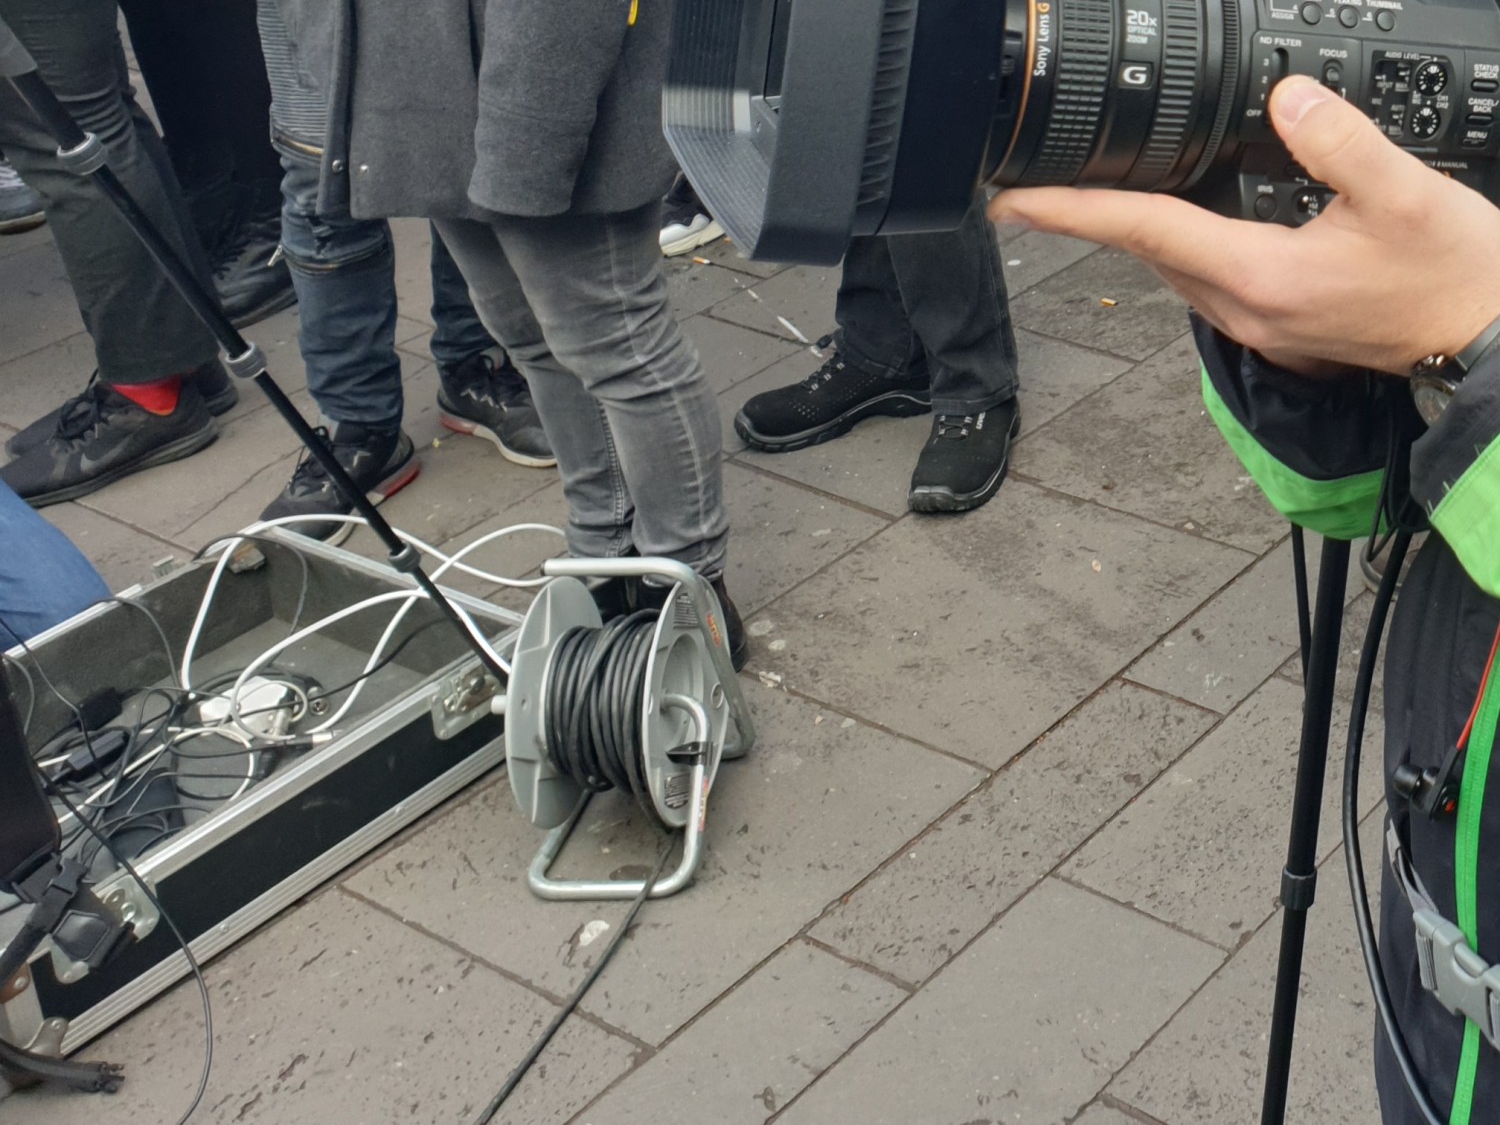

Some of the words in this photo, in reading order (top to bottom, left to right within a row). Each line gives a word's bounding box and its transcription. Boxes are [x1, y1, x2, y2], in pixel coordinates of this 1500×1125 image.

[1037, 2, 1050, 13] G
[1127, 10, 1158, 26] 20x
[1038, 14, 1050, 44] Lens
[1260, 36, 1273, 45] ND
[1274, 37, 1302, 47] FILTER
[1320, 48, 1348, 59] FOCUS
[1034, 46, 1051, 76] Sony
[1474, 63, 1500, 73] STATUS
[1122, 66, 1148, 85] G
